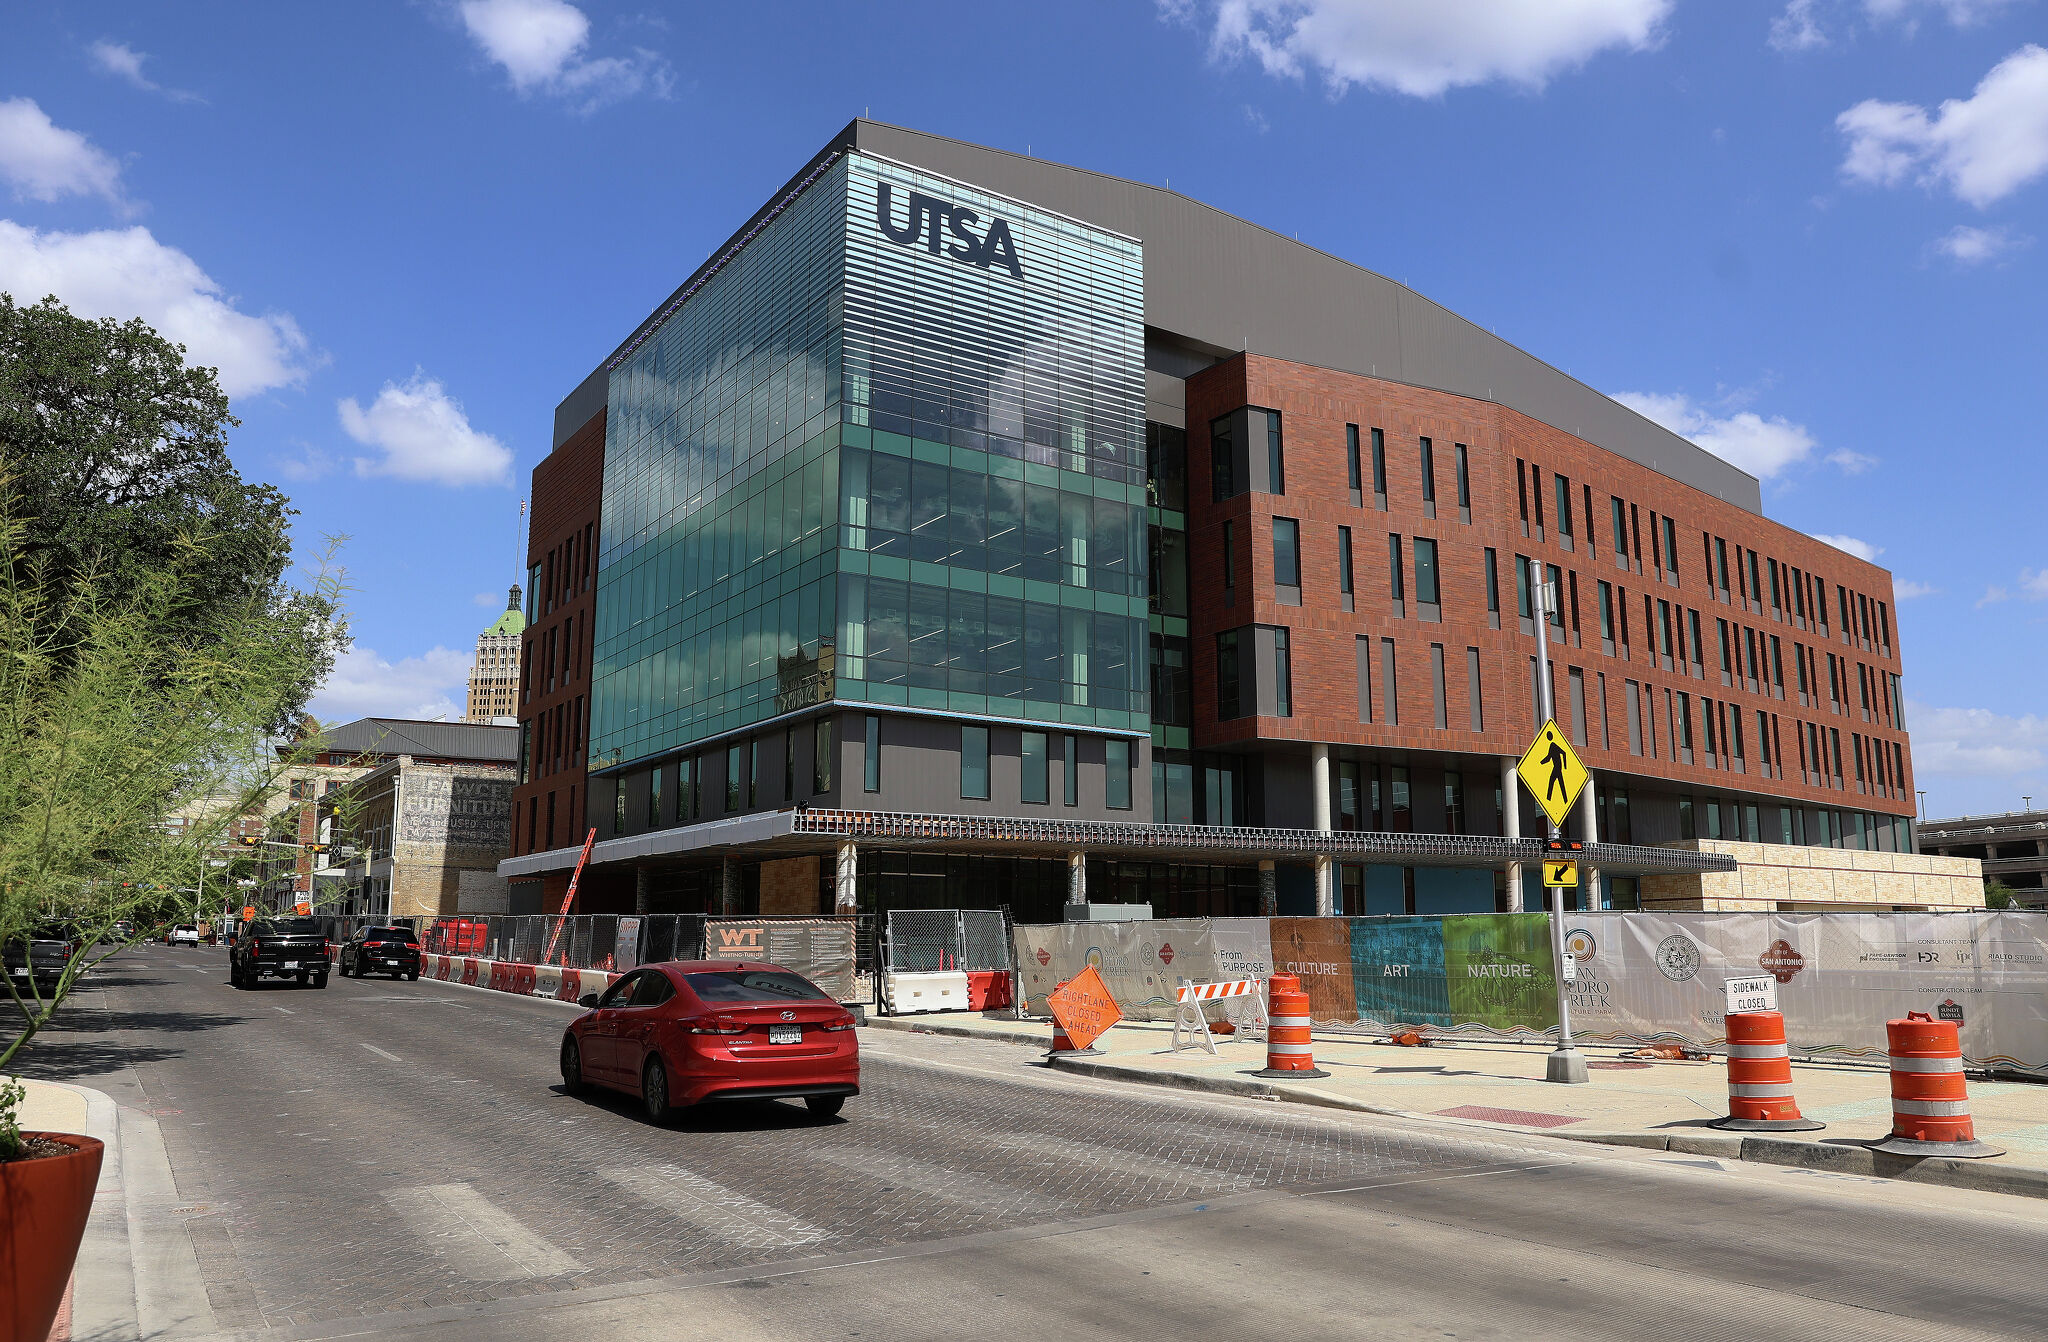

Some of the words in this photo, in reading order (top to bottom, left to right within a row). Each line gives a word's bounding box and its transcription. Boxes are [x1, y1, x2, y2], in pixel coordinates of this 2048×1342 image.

[877, 181, 1024, 279] UTSA
[405, 796, 511, 815] FURNITUR
[450, 818, 477, 829] USED
[719, 928, 764, 946] WT
[1220, 950, 1243, 960] From
[1917, 952, 1940, 963] HDR
[1222, 962, 1265, 972] PURPOSE
[1287, 961, 1339, 975] CULTURE
[1761, 958, 1774, 966] SAN
[1775, 958, 1803, 966] ANTONIO
[1383, 964, 1411, 977] ART
[1467, 964, 1532, 977] NATURE
[1576, 967, 1596, 980] AN
[1733, 981, 1768, 994] SIDEWALK
[1570, 994, 1611, 1008] REEK
[1738, 997, 1766, 1009] CLOSED
[1067, 1006, 1101, 1021] CLOSED
[1068, 1020, 1097, 1036] AHEAD
